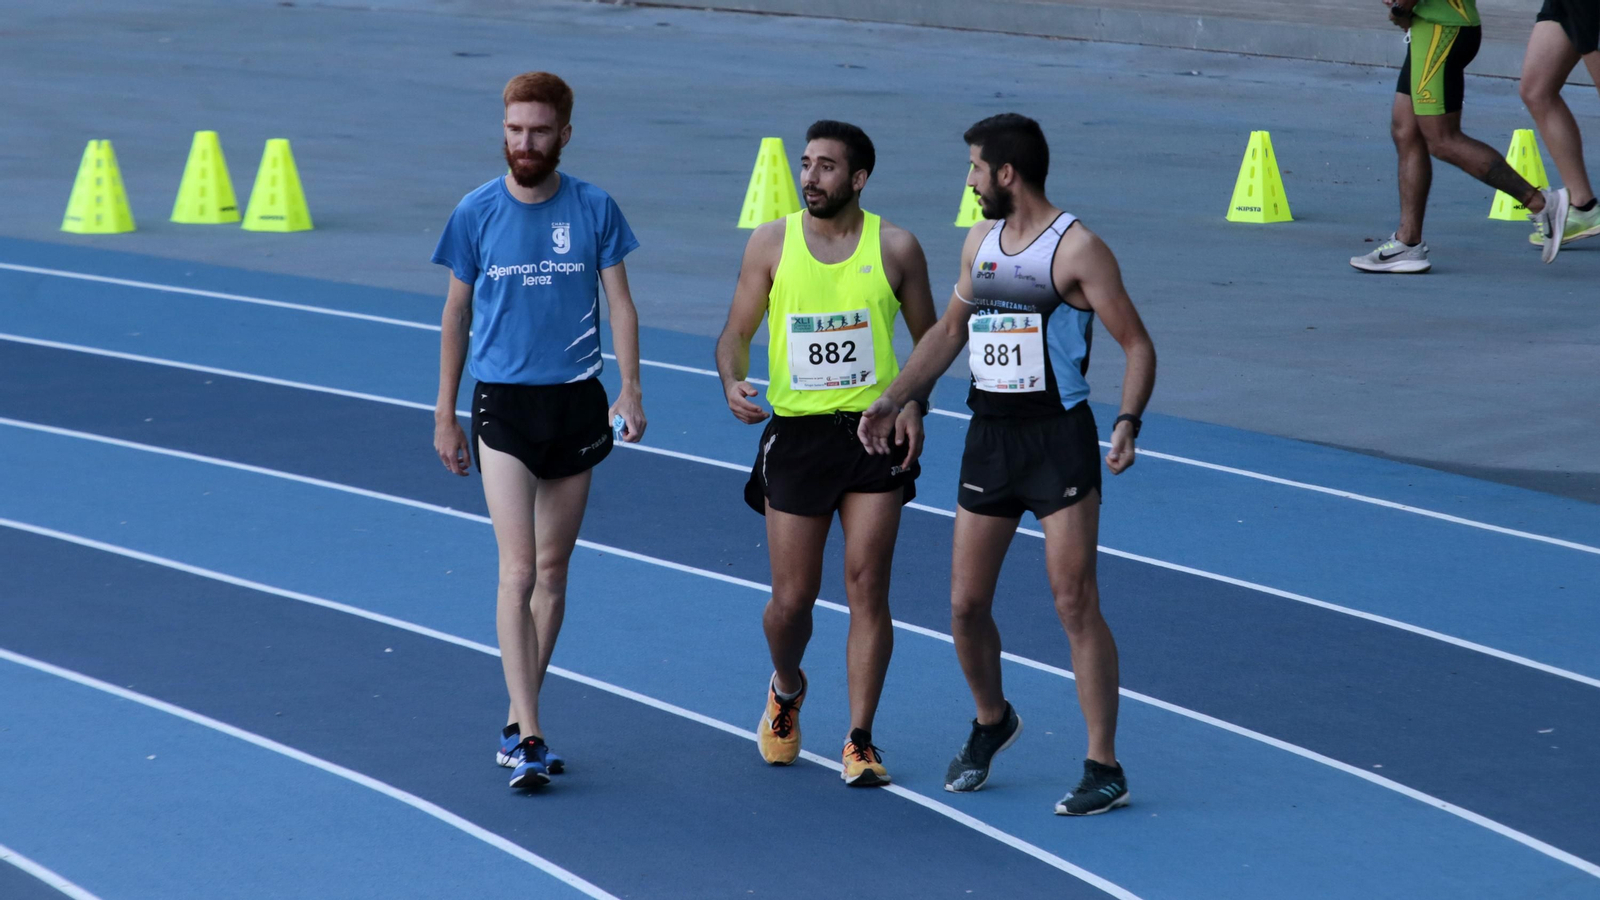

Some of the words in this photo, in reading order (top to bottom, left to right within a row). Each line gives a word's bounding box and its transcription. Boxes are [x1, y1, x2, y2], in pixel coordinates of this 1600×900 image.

[539, 260, 585, 275] Chapin
[522, 275, 552, 287] Jerez
[809, 340, 857, 365] 882
[984, 343, 1022, 366] 881
